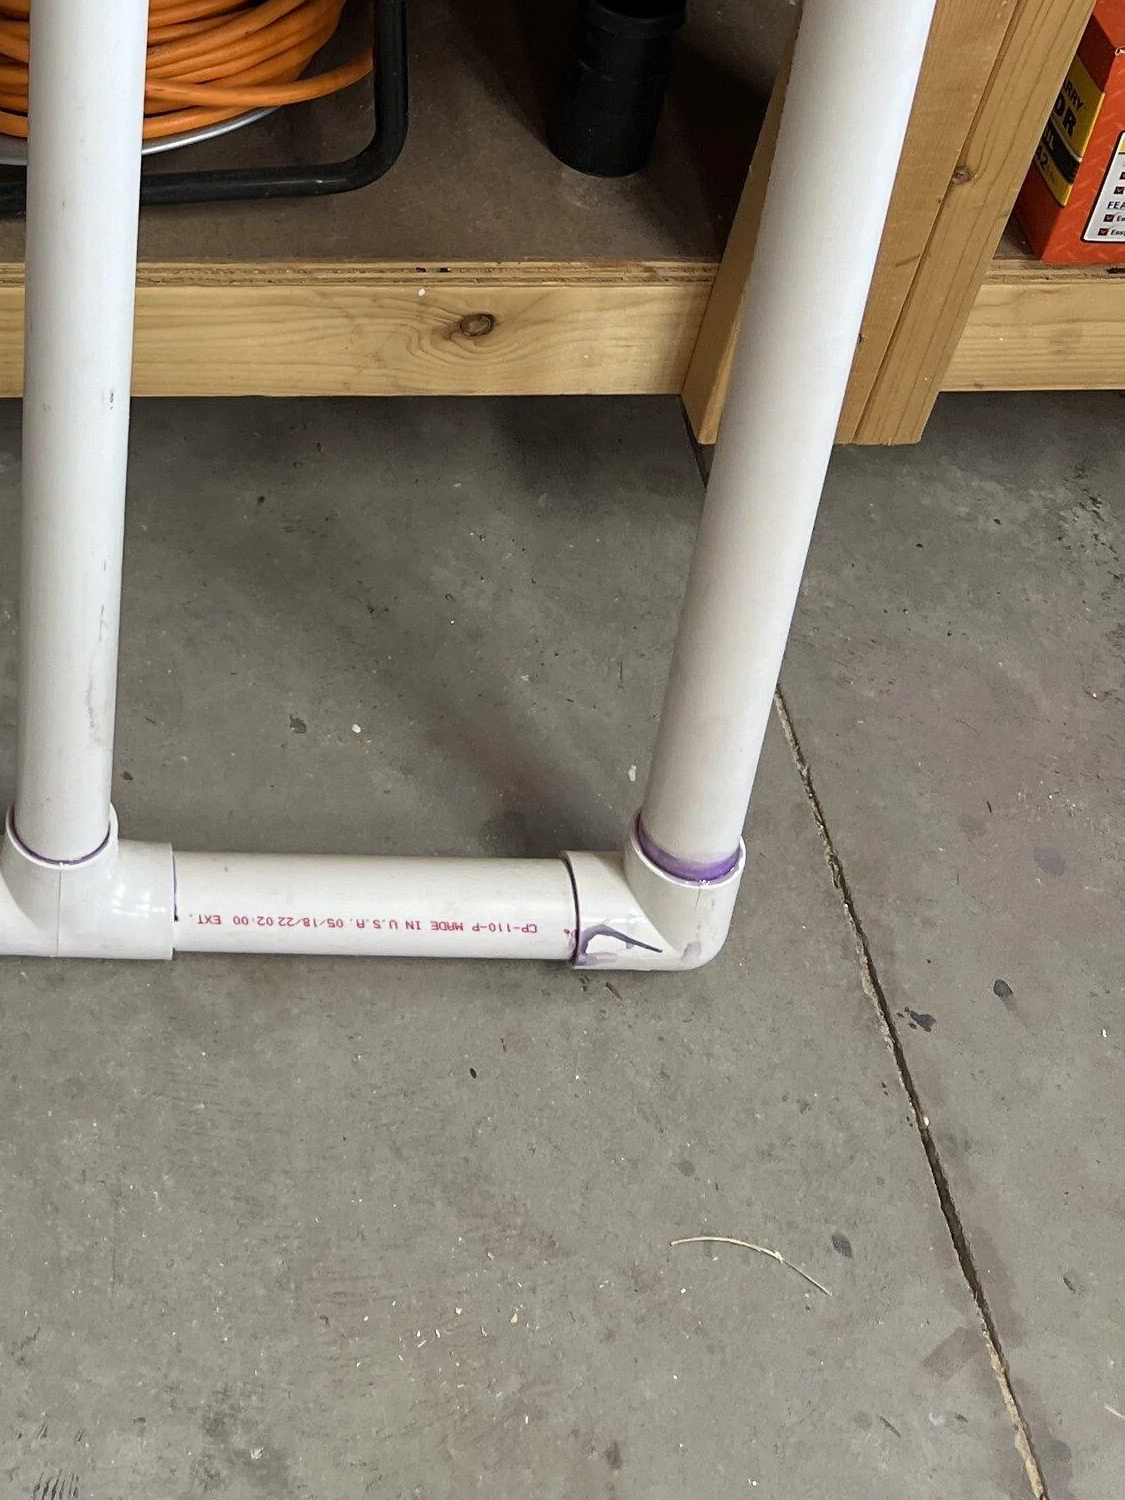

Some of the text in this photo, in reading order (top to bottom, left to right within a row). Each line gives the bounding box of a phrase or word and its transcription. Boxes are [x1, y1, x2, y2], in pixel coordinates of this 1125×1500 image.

[232, 915, 274, 927] 02:00
[277, 916, 344, 929] 05/18/22
[349, 917, 398, 930] U.S.A.
[405, 919, 421, 931] IN
[430, 919, 464, 932] MADE
[471, 921, 538, 934] CP-110-P
